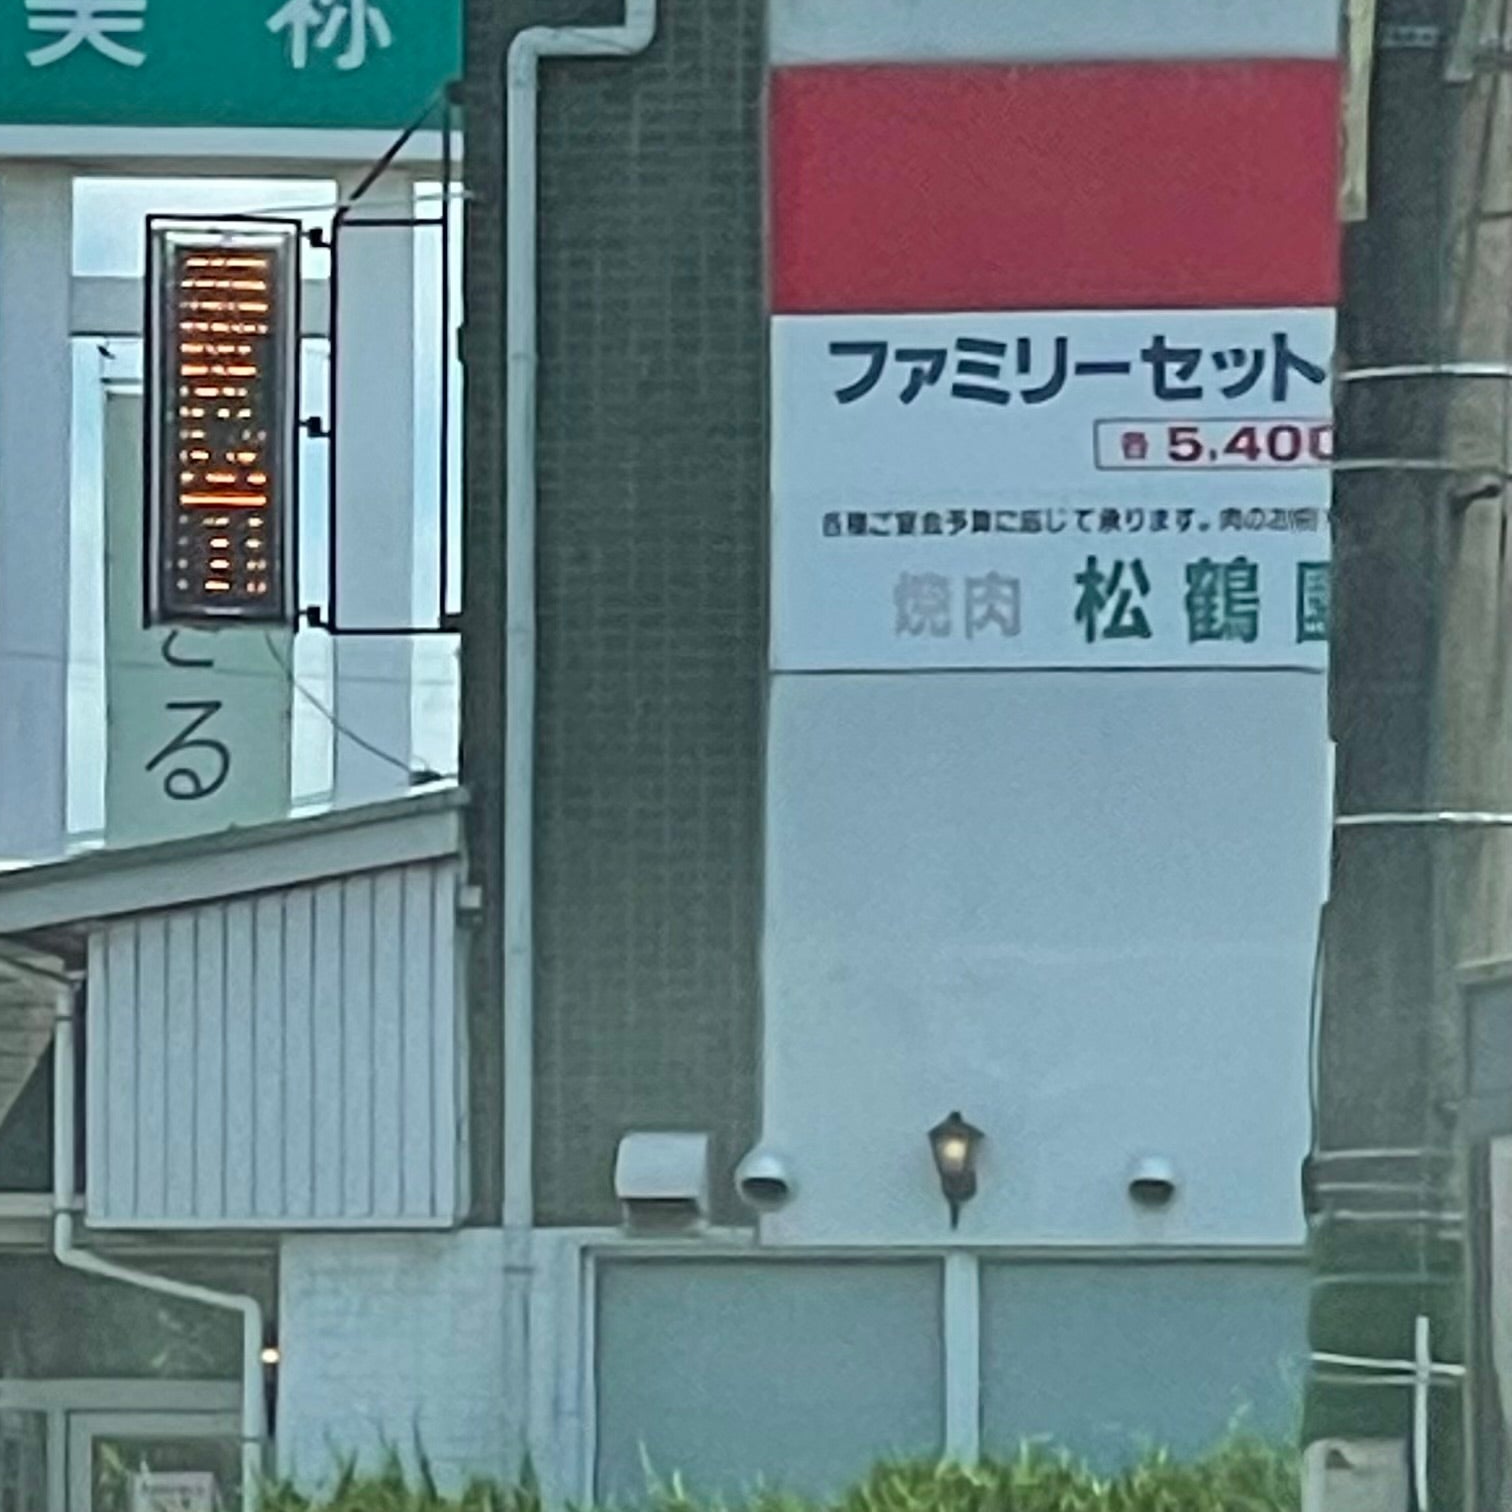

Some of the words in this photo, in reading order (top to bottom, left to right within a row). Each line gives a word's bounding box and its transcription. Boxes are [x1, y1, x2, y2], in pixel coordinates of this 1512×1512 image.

[829, 332, 1325, 405] ファミリーセット
